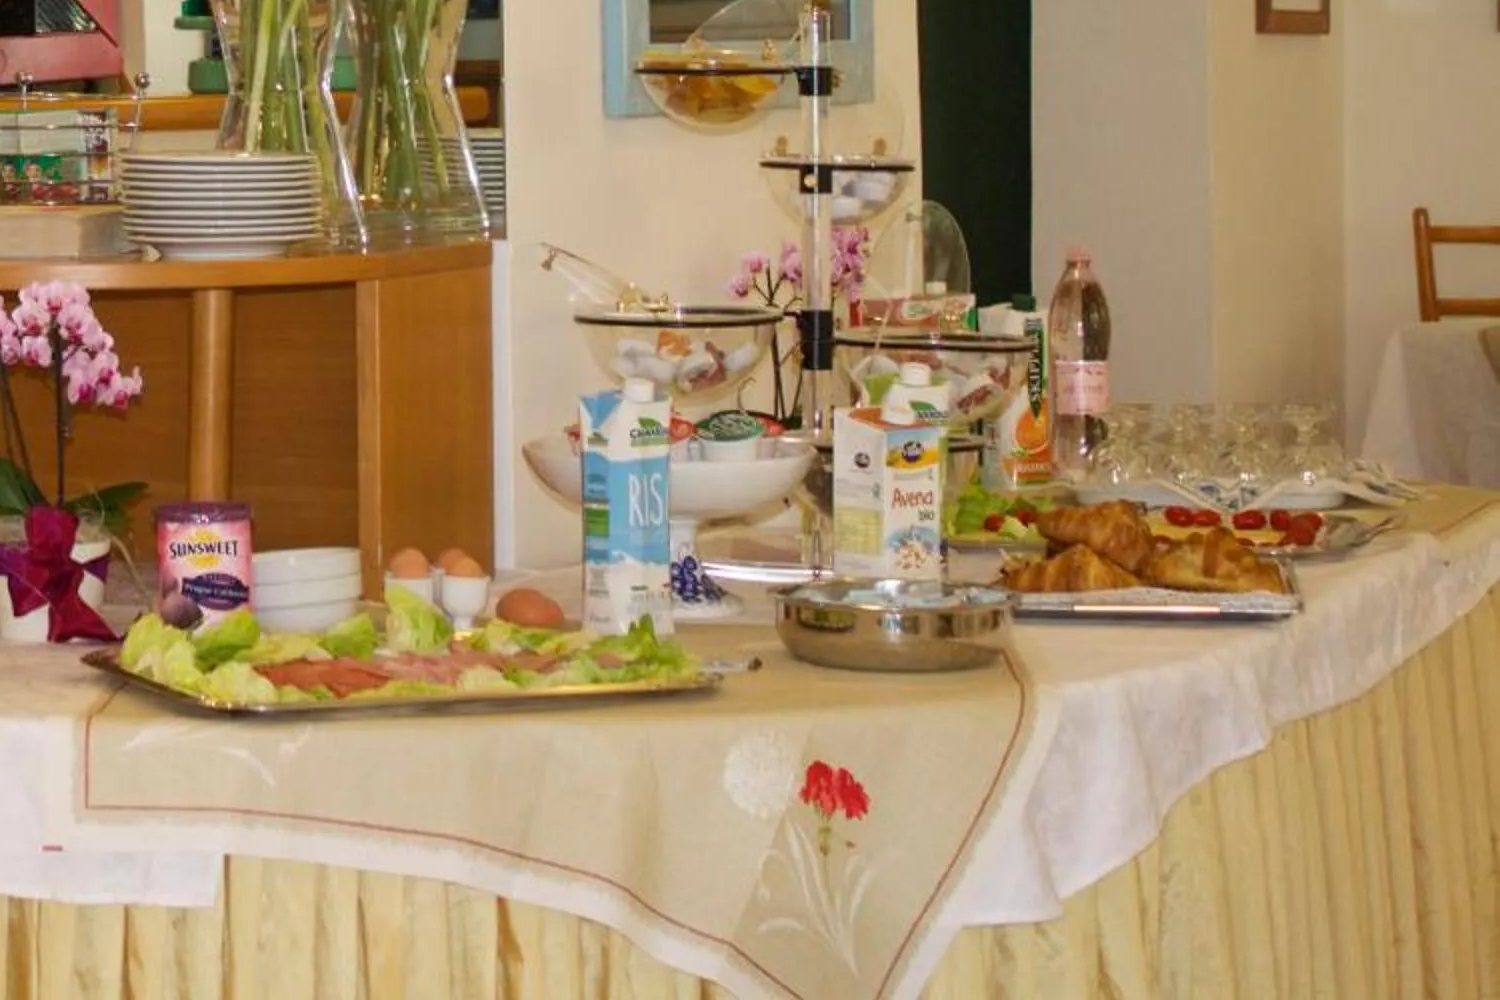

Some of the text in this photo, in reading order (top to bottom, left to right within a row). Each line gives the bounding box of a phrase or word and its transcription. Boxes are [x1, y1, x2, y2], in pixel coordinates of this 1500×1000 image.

[628, 471, 668, 527] RIS
[891, 487, 934, 509] Avena
[169, 540, 239, 560] SUNSWEET
